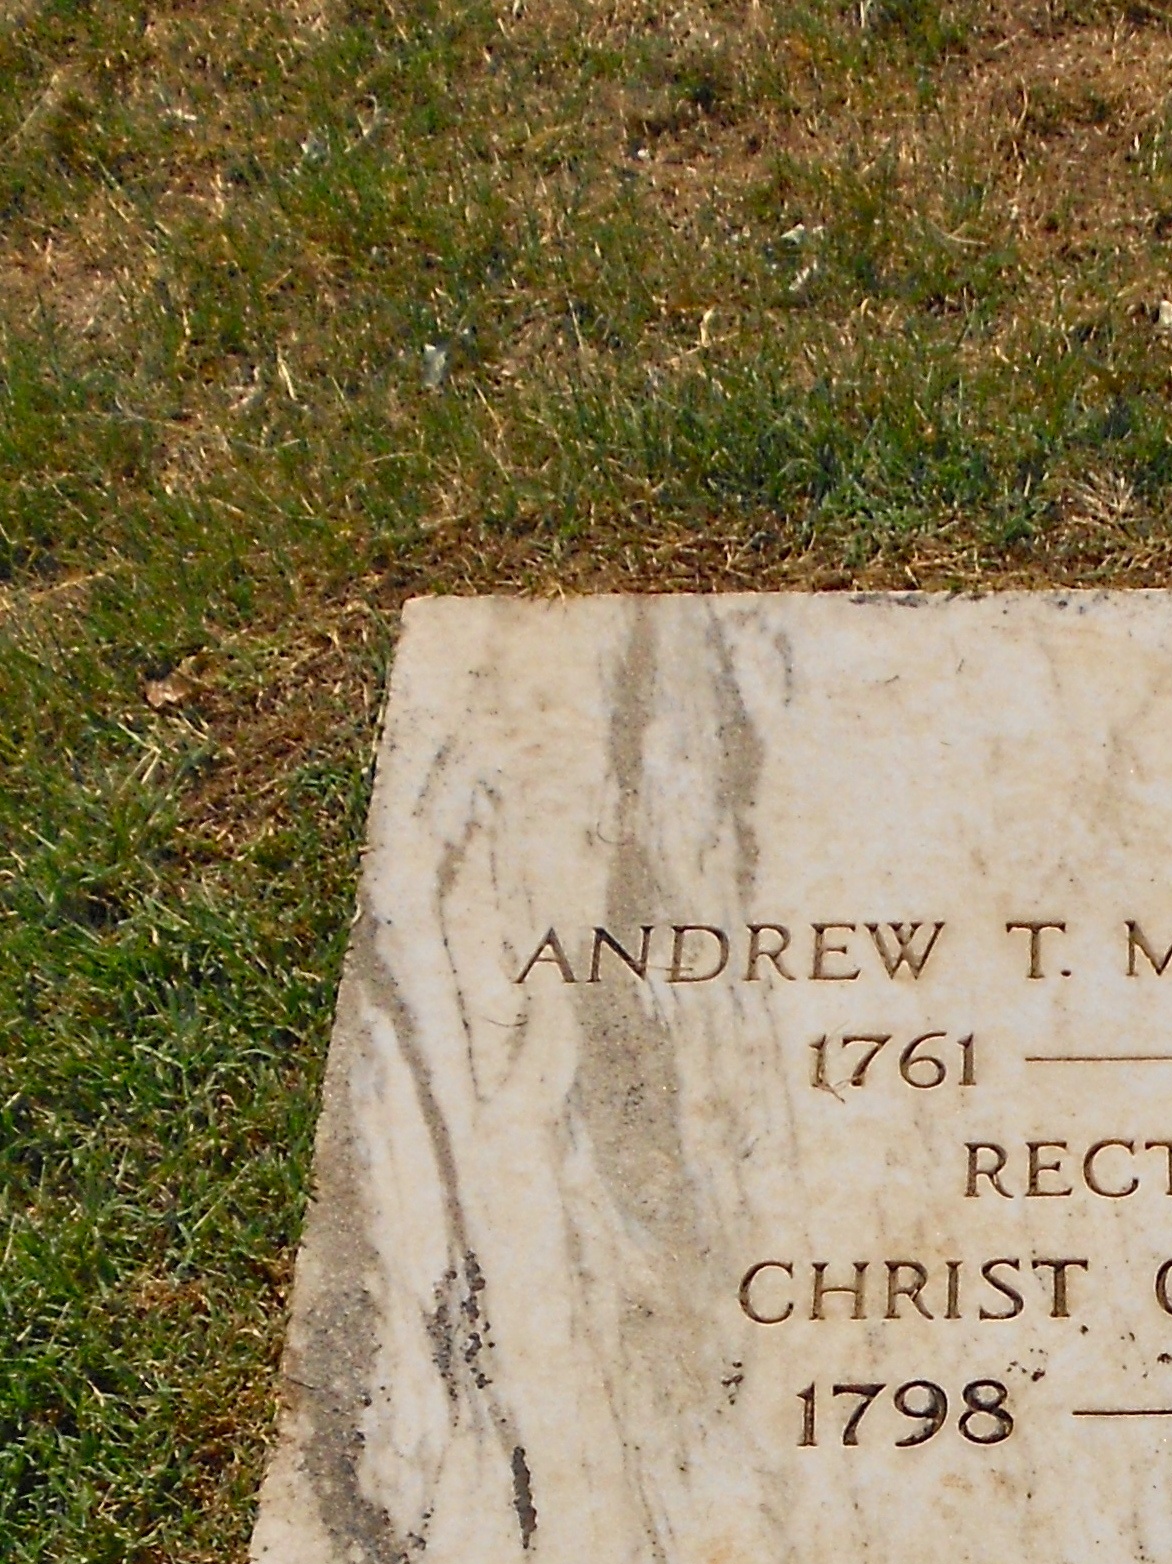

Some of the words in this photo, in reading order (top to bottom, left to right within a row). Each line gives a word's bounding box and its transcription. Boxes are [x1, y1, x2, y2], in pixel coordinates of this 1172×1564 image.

[511, 920, 946, 984] ANDREW
[1005, 920, 1073, 979] T.
[808, 1031, 978, 1090] 1761
[737, 1258, 1090, 1325] CHRIST
[796, 1379, 1016, 1449] 1798
